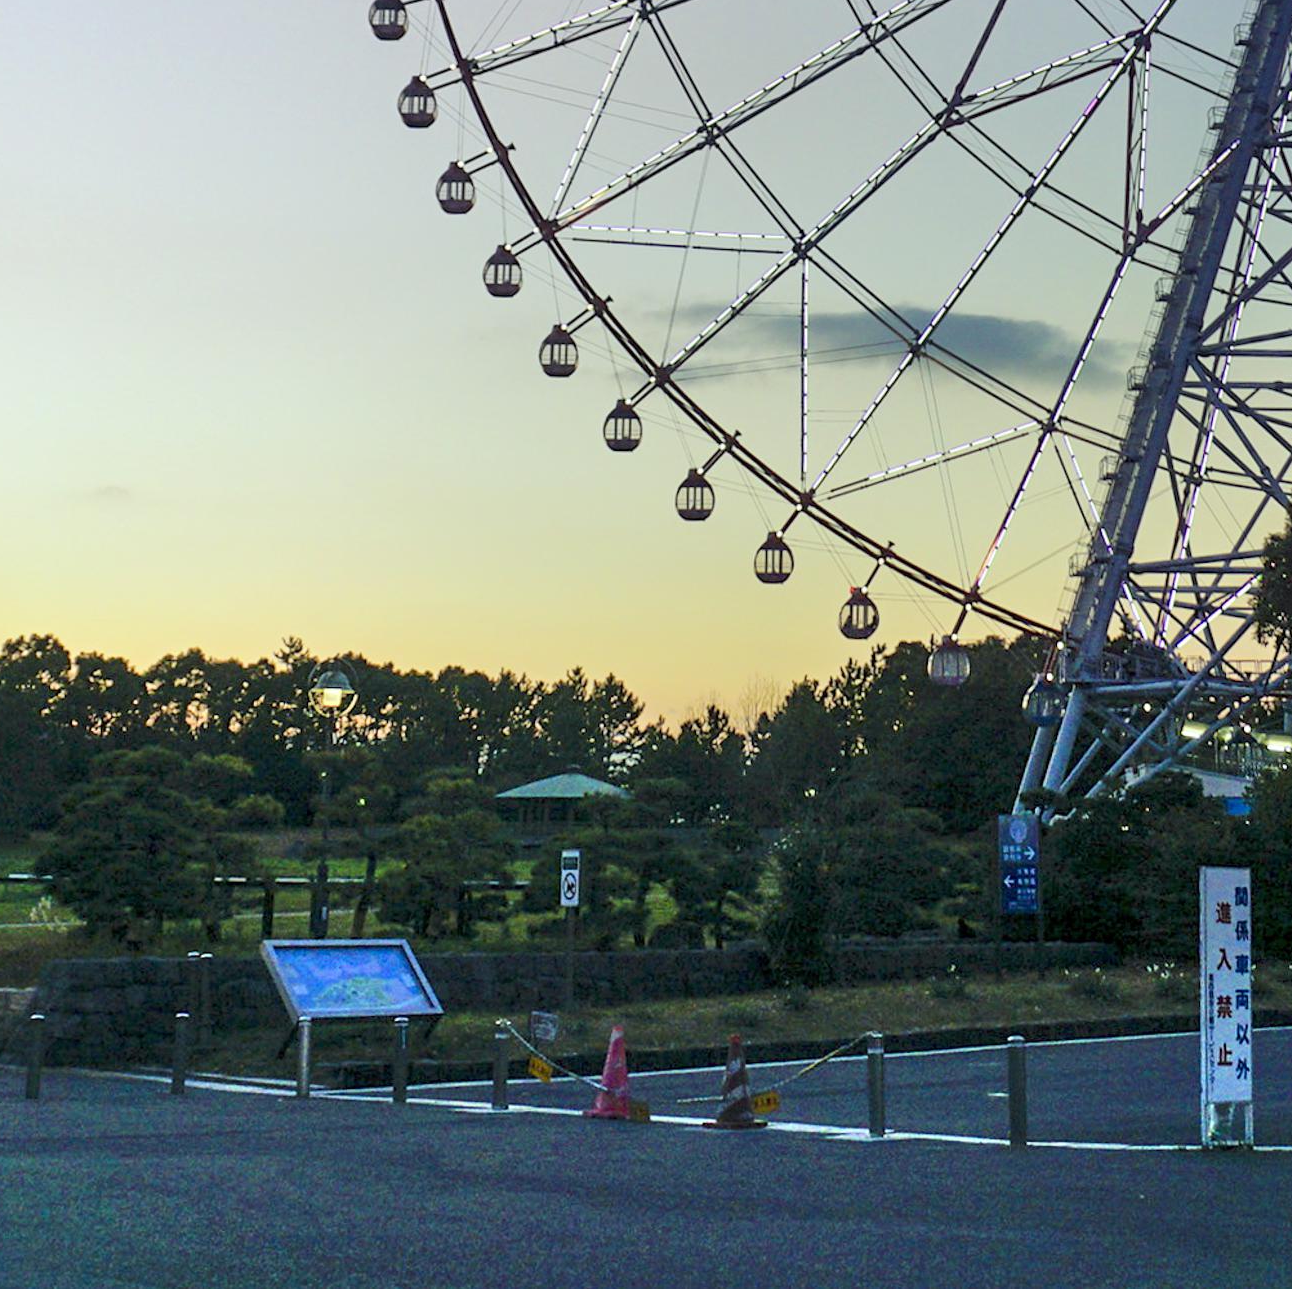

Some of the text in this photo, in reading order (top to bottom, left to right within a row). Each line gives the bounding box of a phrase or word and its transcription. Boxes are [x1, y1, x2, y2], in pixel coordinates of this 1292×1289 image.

[1215, 902, 1233, 1067] 進入禁止
[1235, 886, 1250, 1080] 関係車両以外
